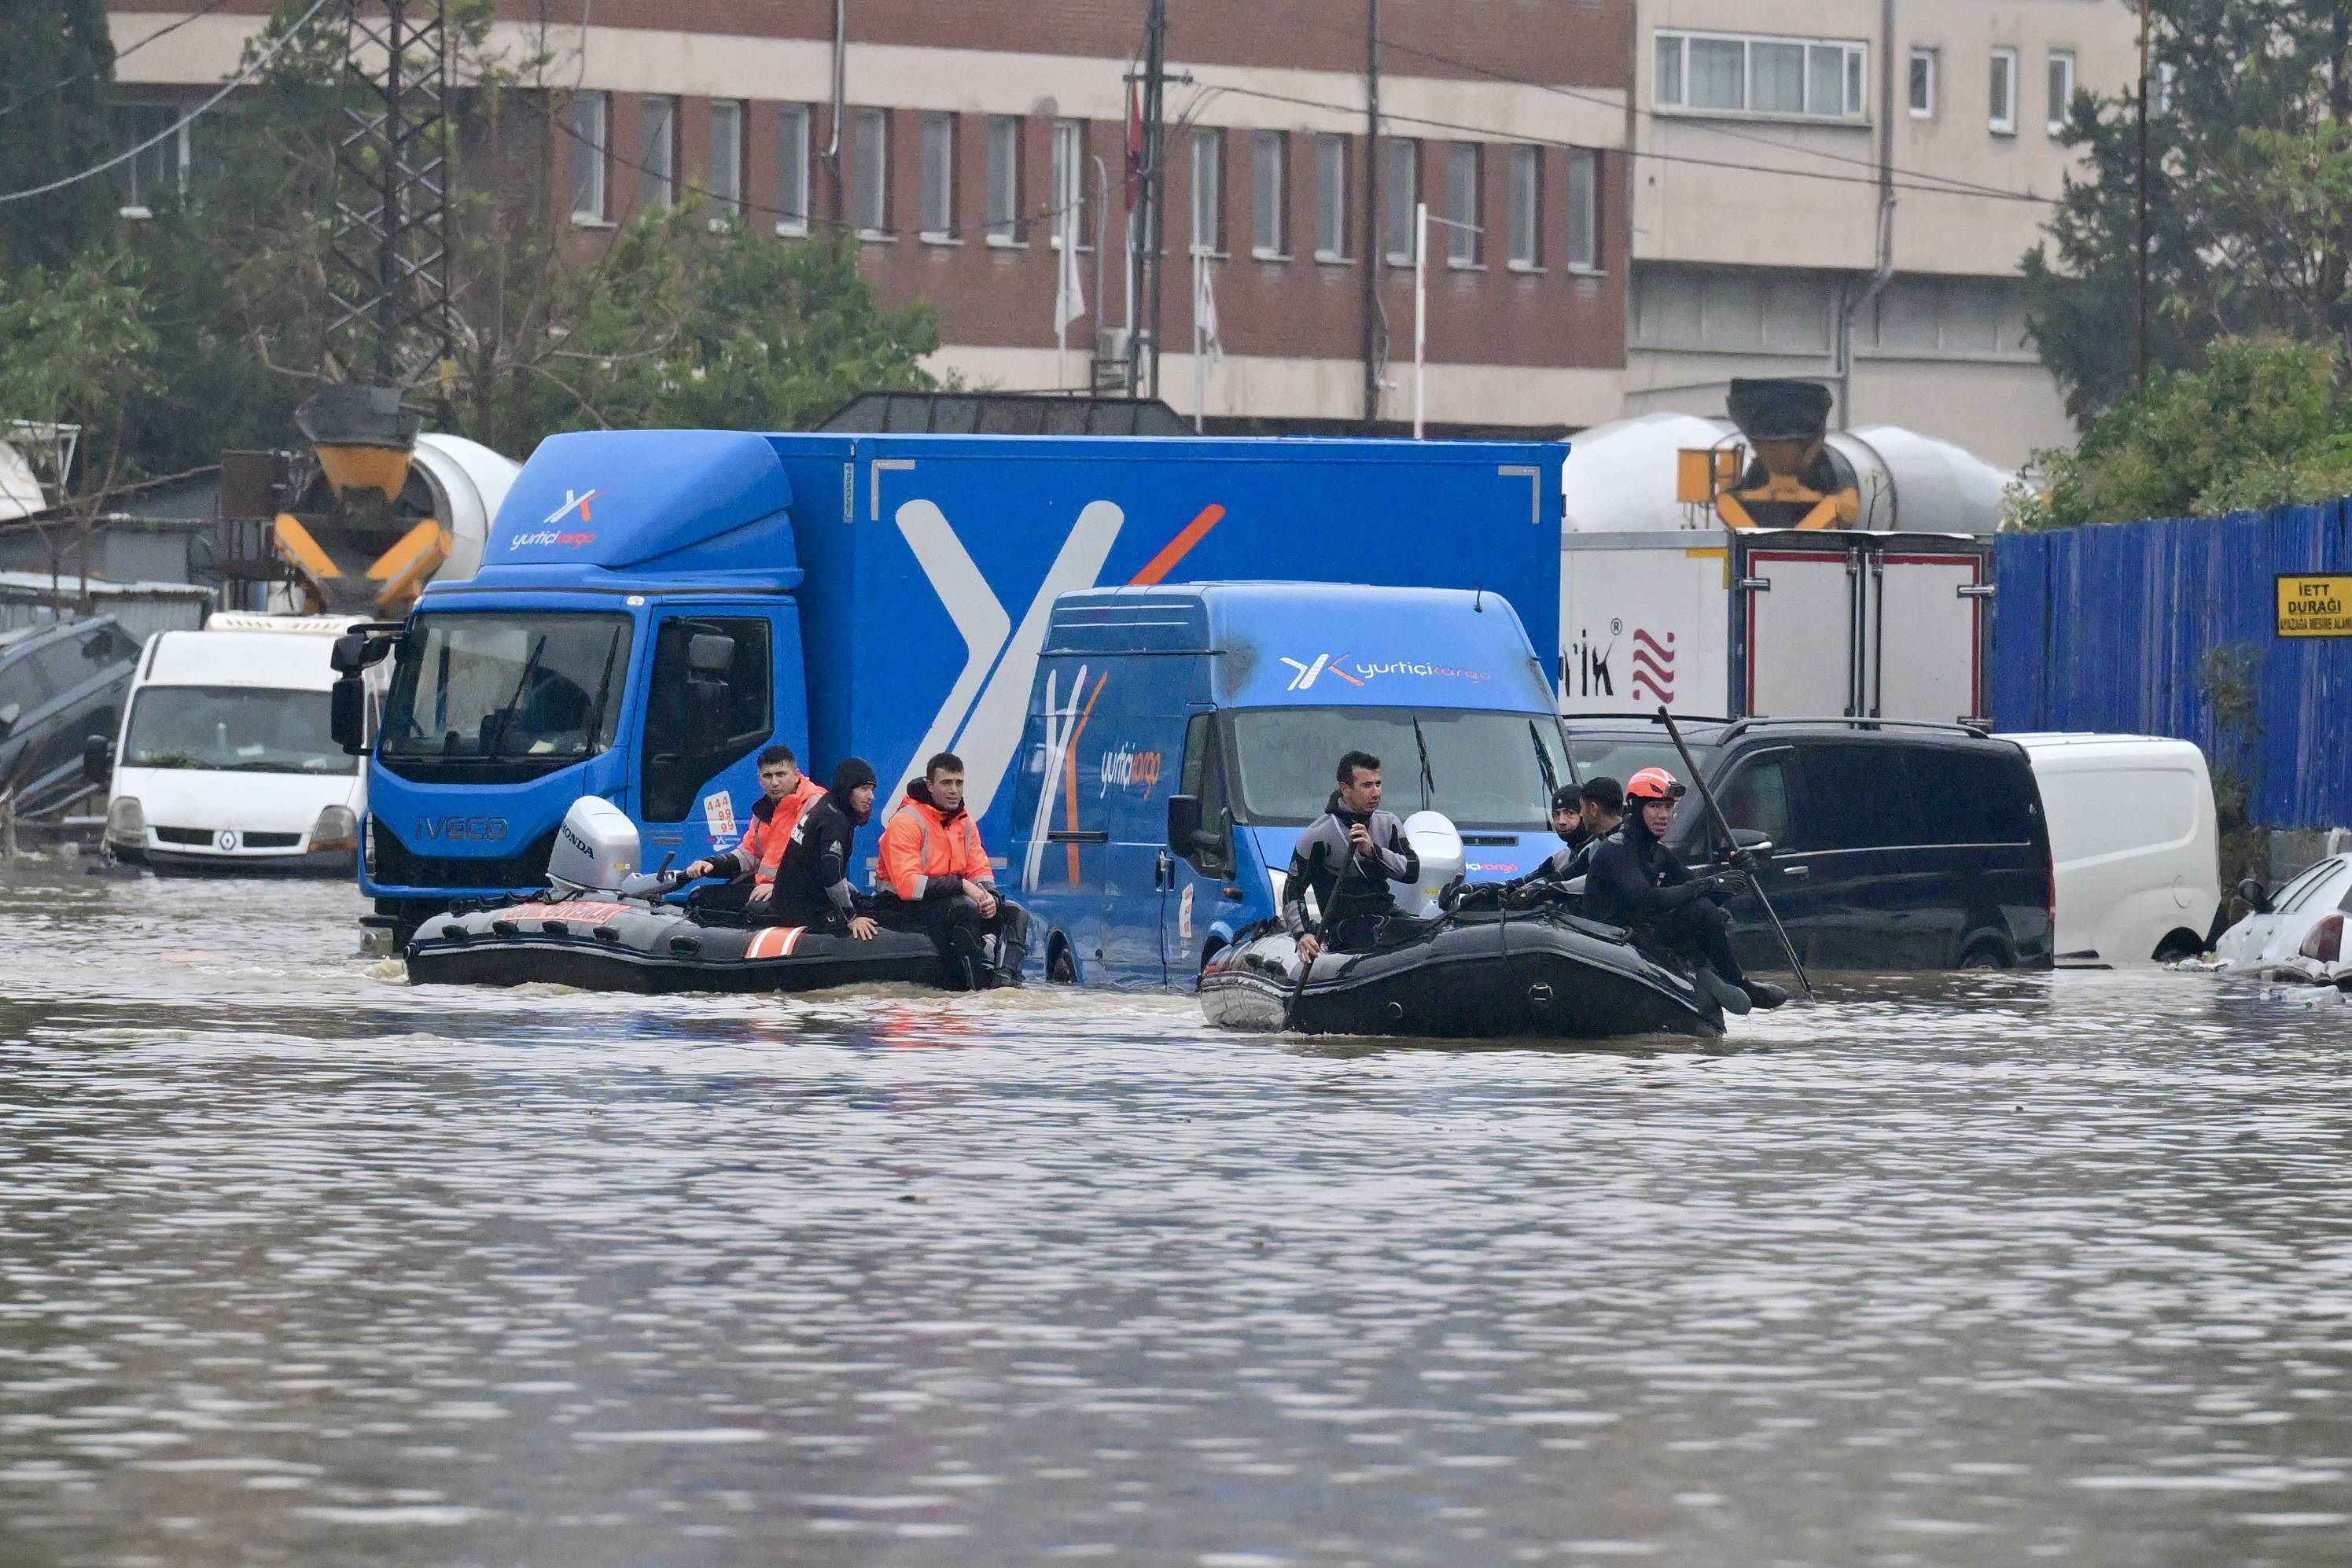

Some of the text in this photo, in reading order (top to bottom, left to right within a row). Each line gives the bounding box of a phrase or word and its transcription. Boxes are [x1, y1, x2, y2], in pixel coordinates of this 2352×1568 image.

[2299, 582, 2330, 596] İETT
[2288, 598, 2342, 614] DURAĞI
[707, 796, 729, 811] 444
[718, 808, 732, 820] 99
[415, 817, 507, 840] IVECO
[720, 820, 734, 833] 99
[561, 821, 594, 859] HONDA
